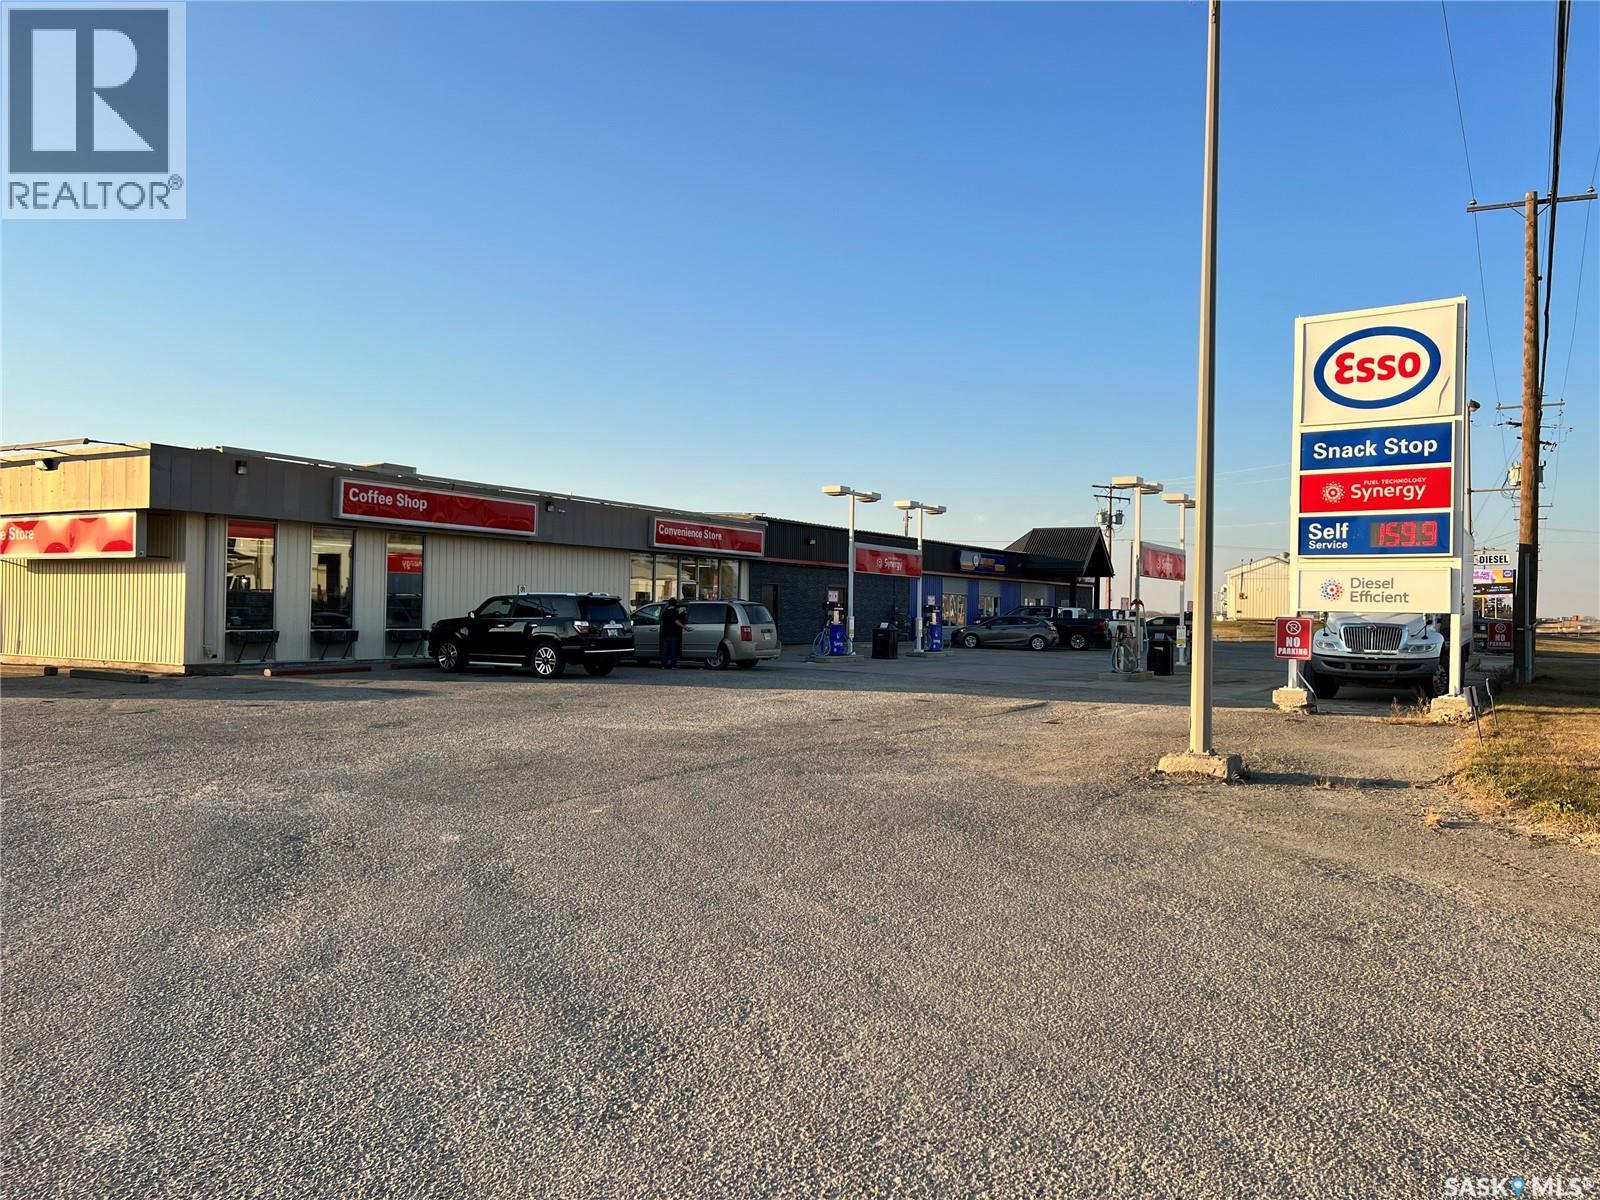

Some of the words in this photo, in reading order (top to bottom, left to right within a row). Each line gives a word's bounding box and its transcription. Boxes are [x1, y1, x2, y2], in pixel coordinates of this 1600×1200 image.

[1313, 440, 1377, 459] Snack
[1384, 437, 1438, 458] Stop
[349, 486, 393, 506] Coffee
[396, 492, 428, 512] Shop
[1350, 483, 1426, 502] Synergy
[9, 526, 34, 542] Store
[658, 523, 703, 540] Convenience
[704, 528, 723, 542] Store
[1308, 522, 1349, 540] Self
[1380, 521, 1438, 546] 159.9
[1308, 540, 1349, 550] Service
[1480, 555, 1508, 564] DIESEL
[1350, 576, 1394, 590] Diesel
[1350, 590, 1410, 604] Efficient
[1285, 636, 1301, 648] NO
[1277, 647, 1308, 655] PARKING
